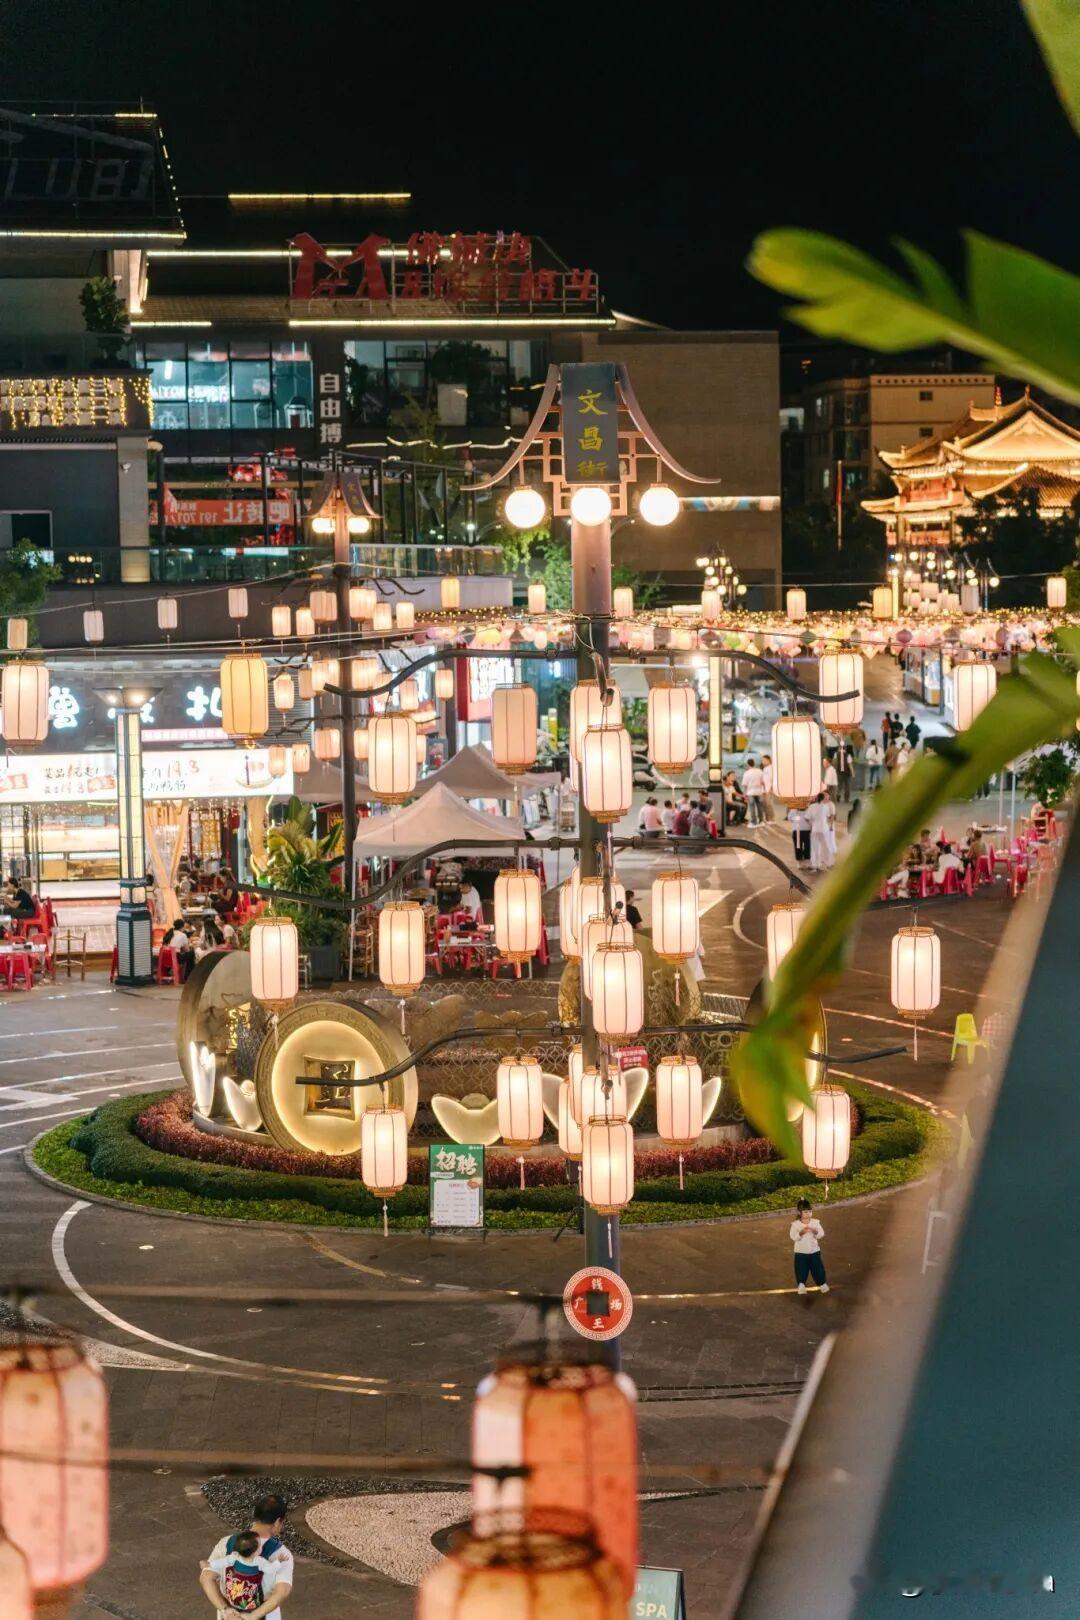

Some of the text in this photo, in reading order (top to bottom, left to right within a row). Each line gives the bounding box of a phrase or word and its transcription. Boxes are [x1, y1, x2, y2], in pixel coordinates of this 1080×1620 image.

[577, 389, 608, 477] 文昌街
[436, 1146, 478, 1175] 招聘
[635, 1601, 668, 1619] SPA
